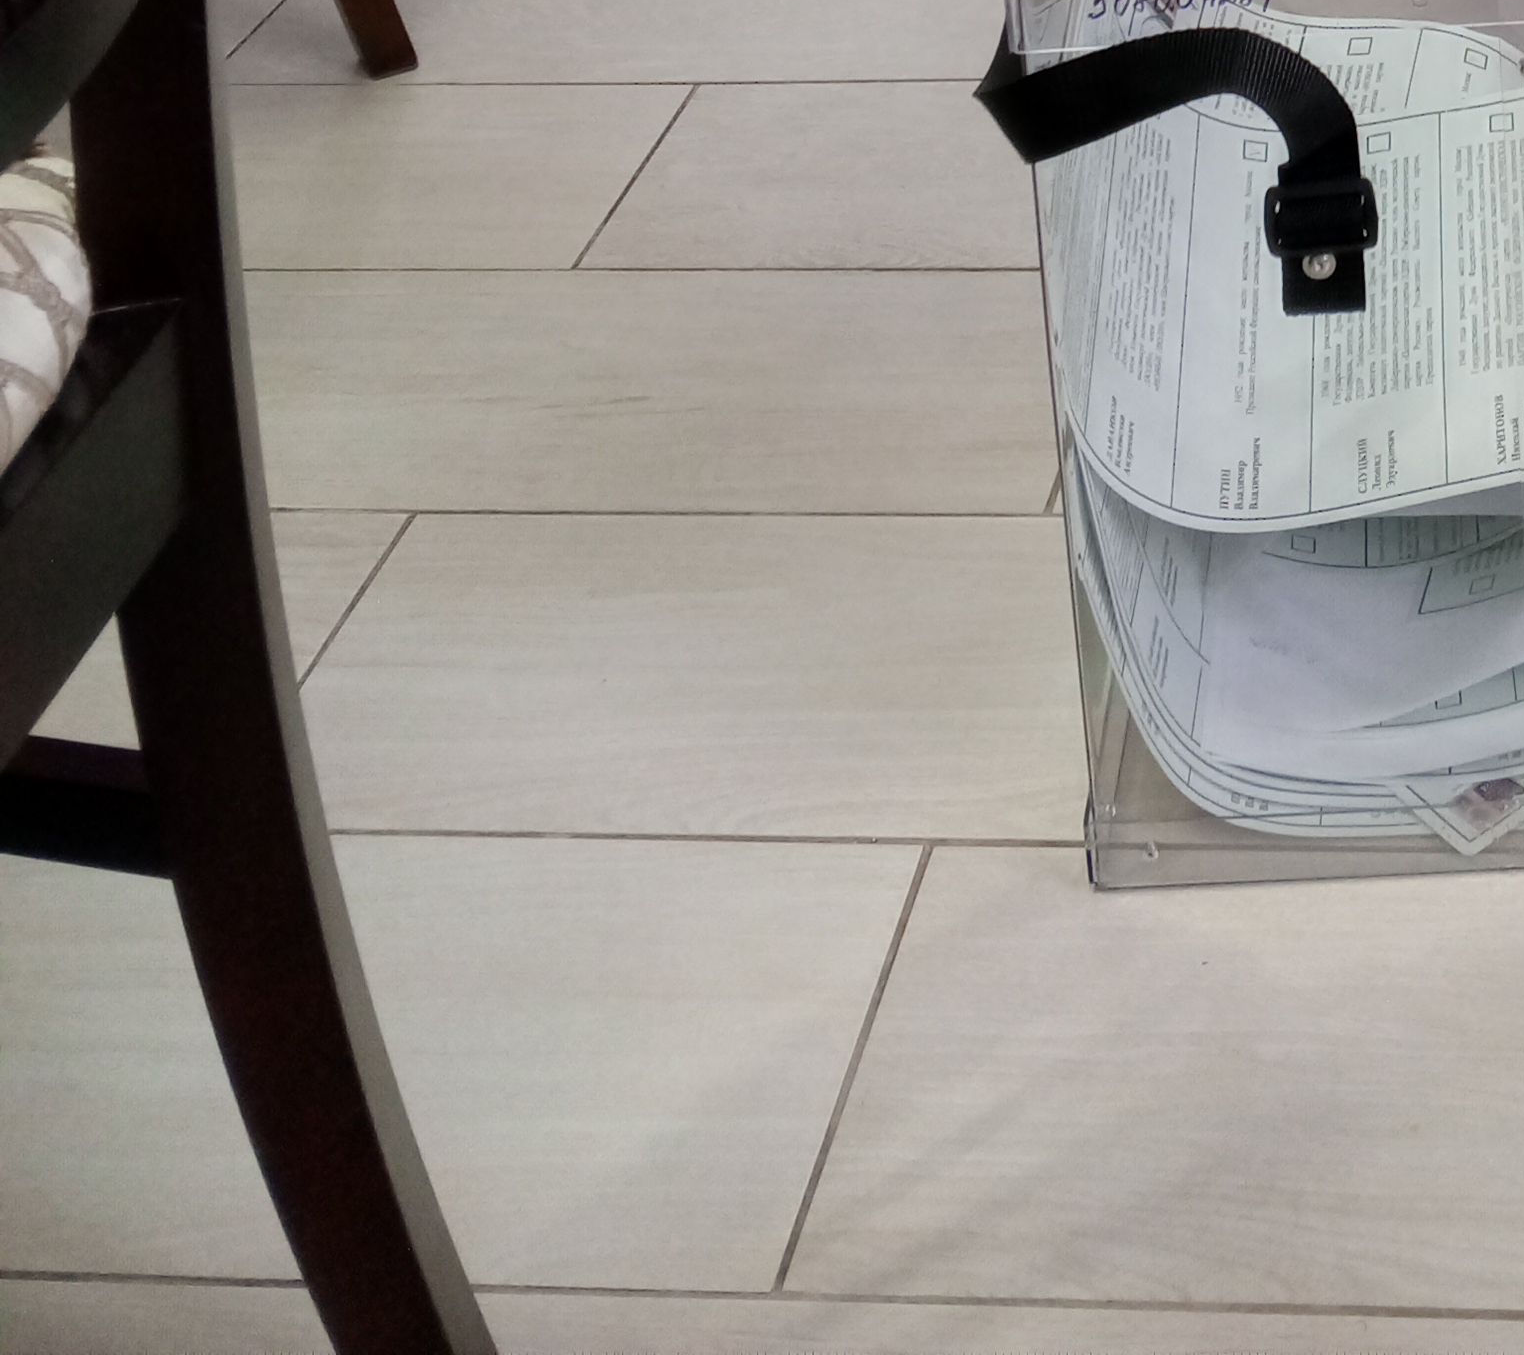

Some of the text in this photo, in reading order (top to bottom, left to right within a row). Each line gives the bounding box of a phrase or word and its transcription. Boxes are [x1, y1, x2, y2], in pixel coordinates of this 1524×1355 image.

[1494, 394, 1507, 465] ХАРИТОНОВ
[1218, 469, 1231, 510] ПУТИН
[1356, 438, 1368, 494] СЛУЦКИЙ
